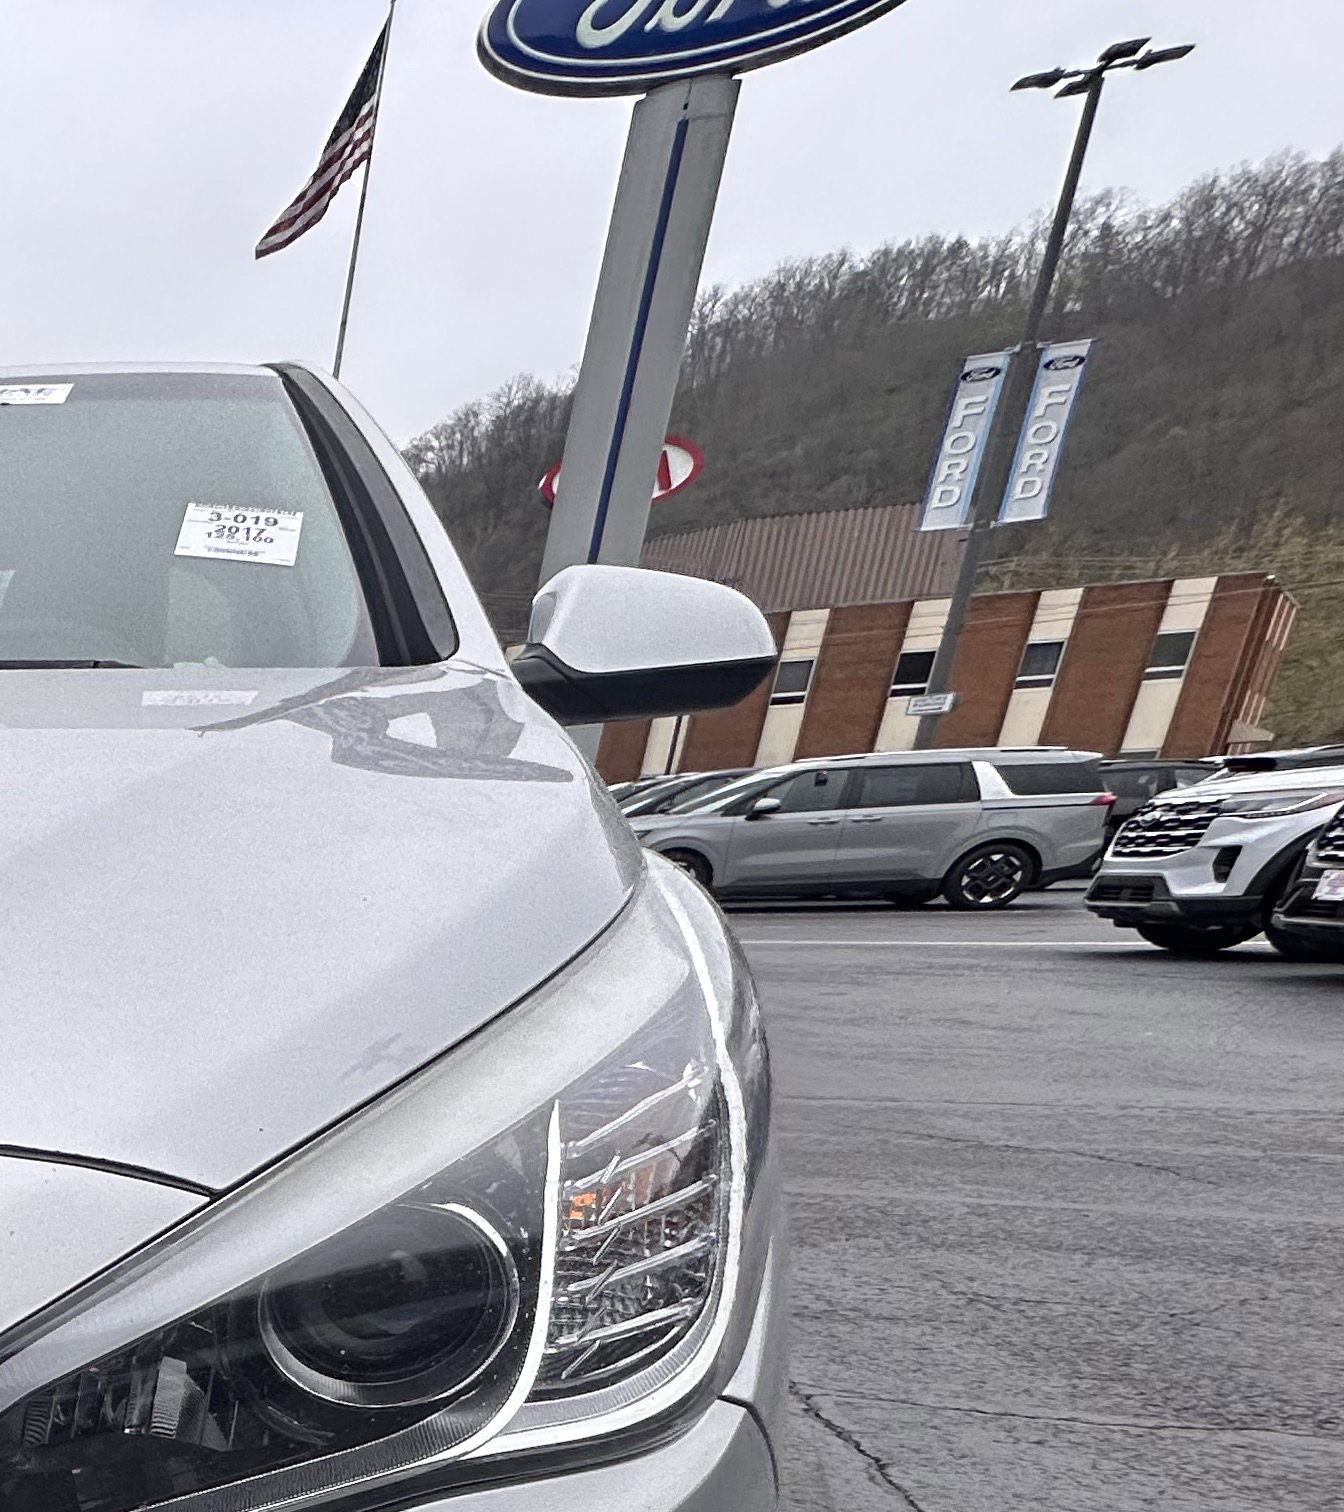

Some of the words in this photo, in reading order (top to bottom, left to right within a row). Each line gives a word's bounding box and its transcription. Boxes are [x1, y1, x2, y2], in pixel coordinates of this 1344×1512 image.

[931, 395, 989, 510] FORD
[1013, 384, 1072, 501] FORD
[208, 511, 278, 526] 3-019
